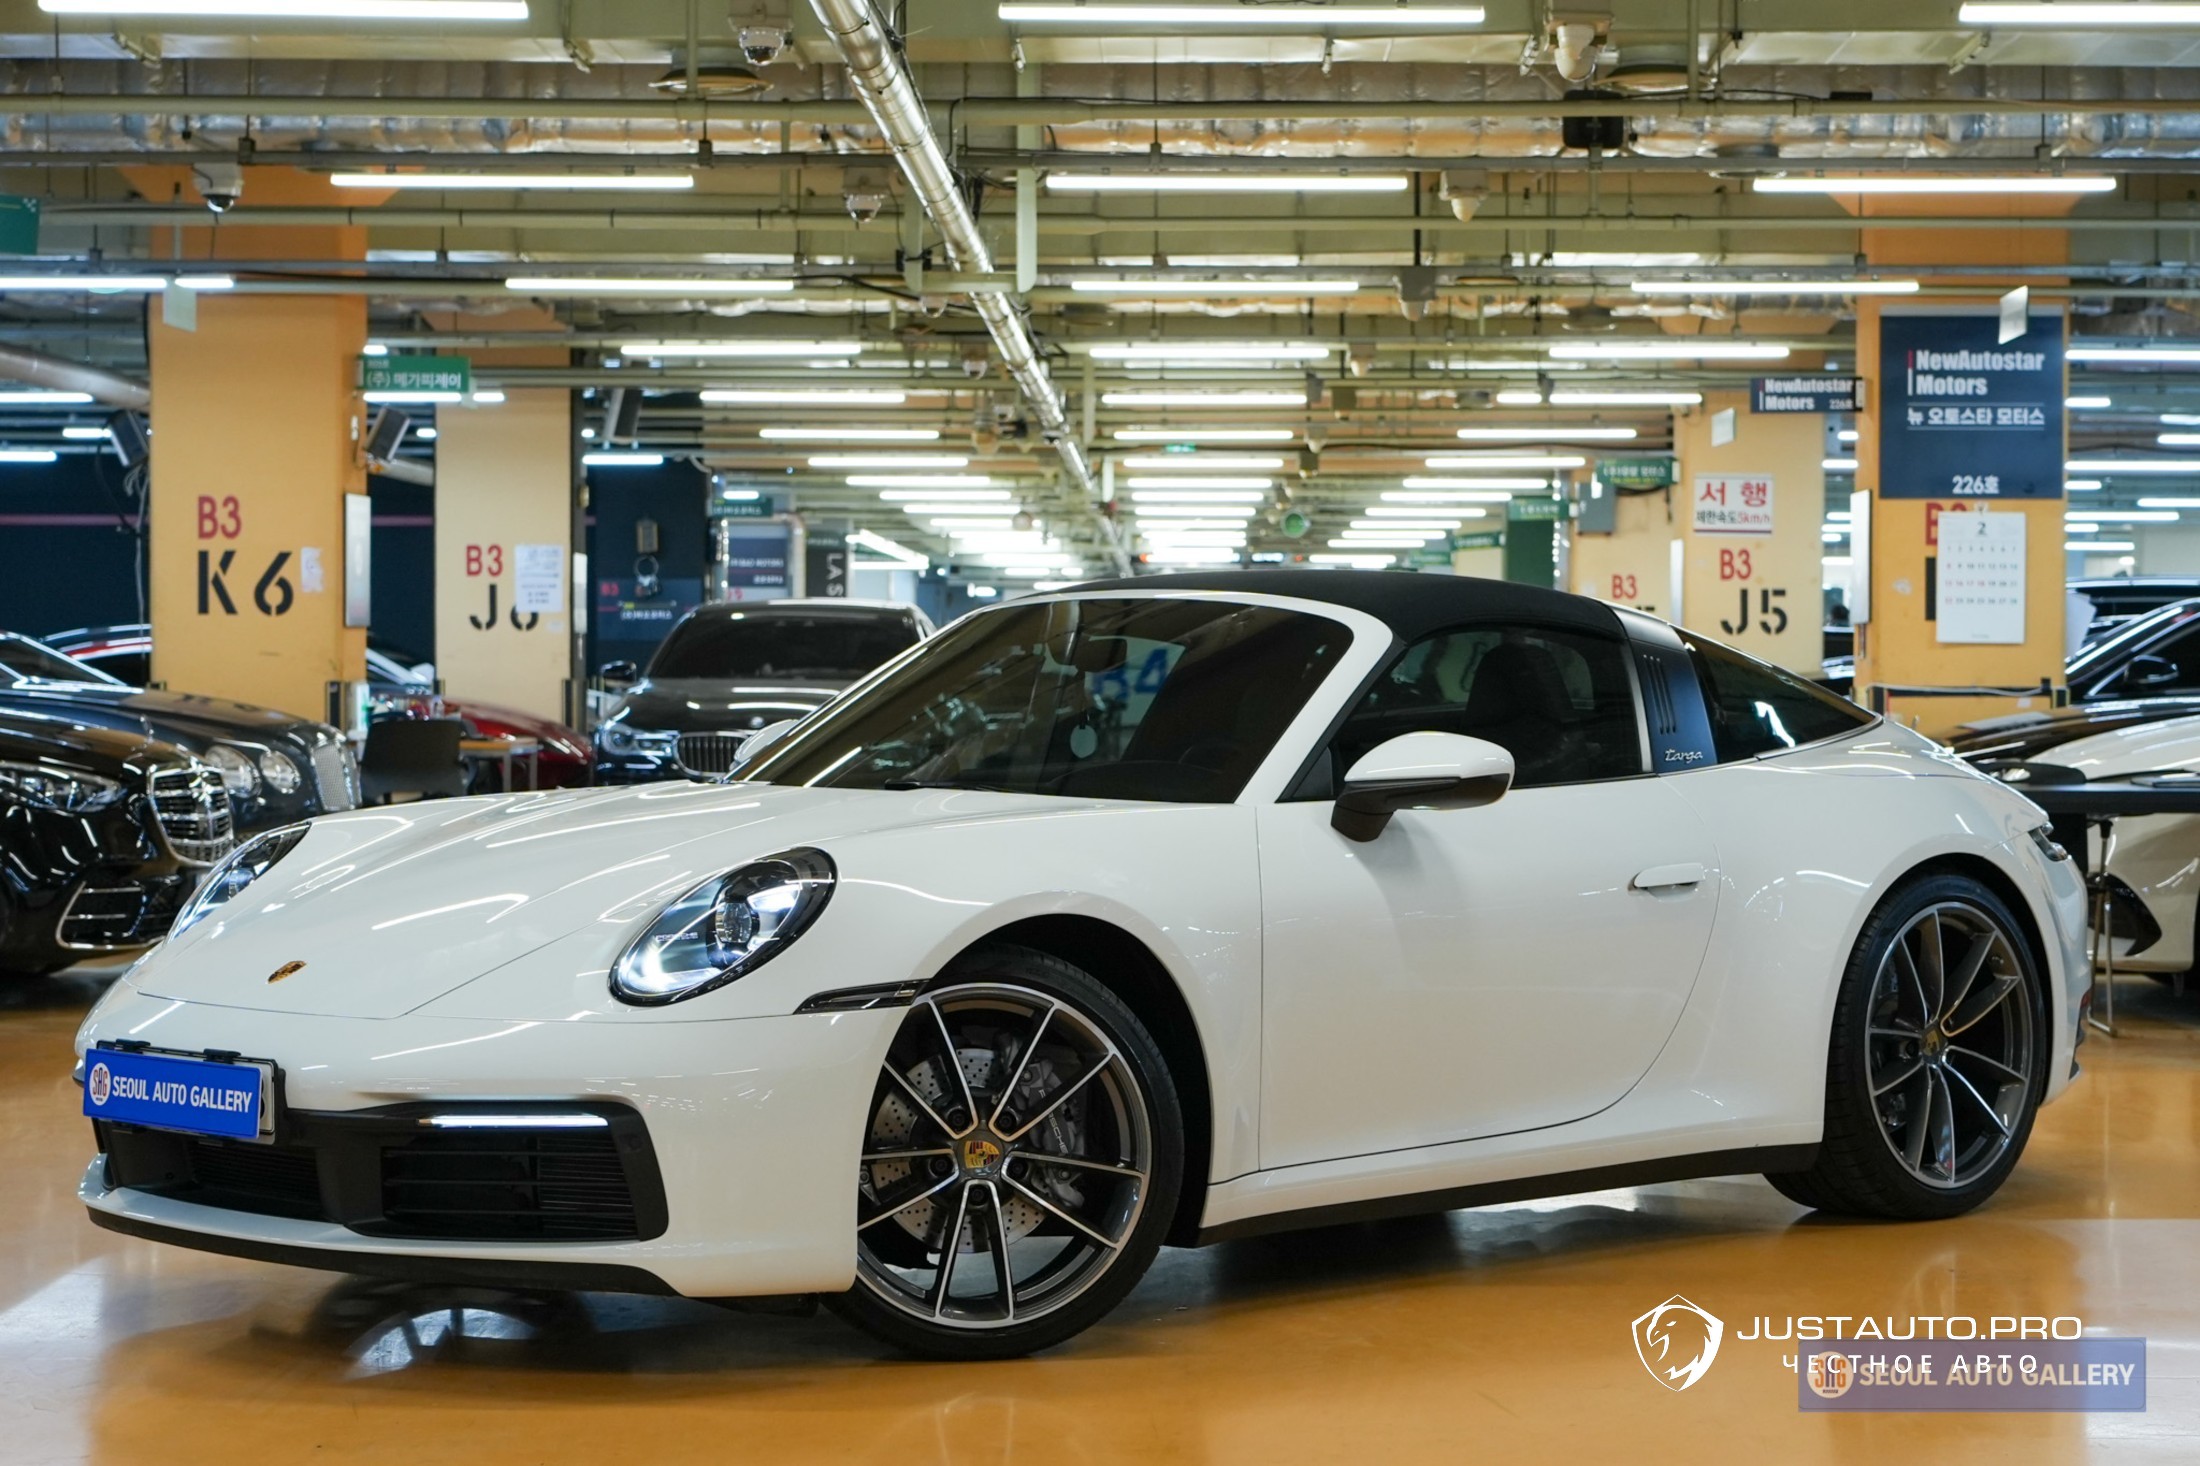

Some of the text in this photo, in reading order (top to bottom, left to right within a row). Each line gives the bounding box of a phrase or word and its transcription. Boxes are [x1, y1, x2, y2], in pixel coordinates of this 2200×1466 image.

[1916, 350, 2045, 370] NewAutostar
[1765, 379, 1853, 392] NewAutostar
[1916, 374, 1988, 395] Motors
[1765, 396, 1815, 410] Motors
[1908, 408, 2045, 425] 뉴 오토스타 모터스
[1952, 475, 1999, 494] 226호
[199, 496, 242, 540] B3
[466, 545, 503, 577] B3
[1720, 549, 1752, 580] B3
[1612, 574, 1637, 599] B3
[112, 1075, 149, 1100] SEOUL
[152, 1081, 187, 1106] AUTO
[190, 1085, 252, 1113] GALLERY
